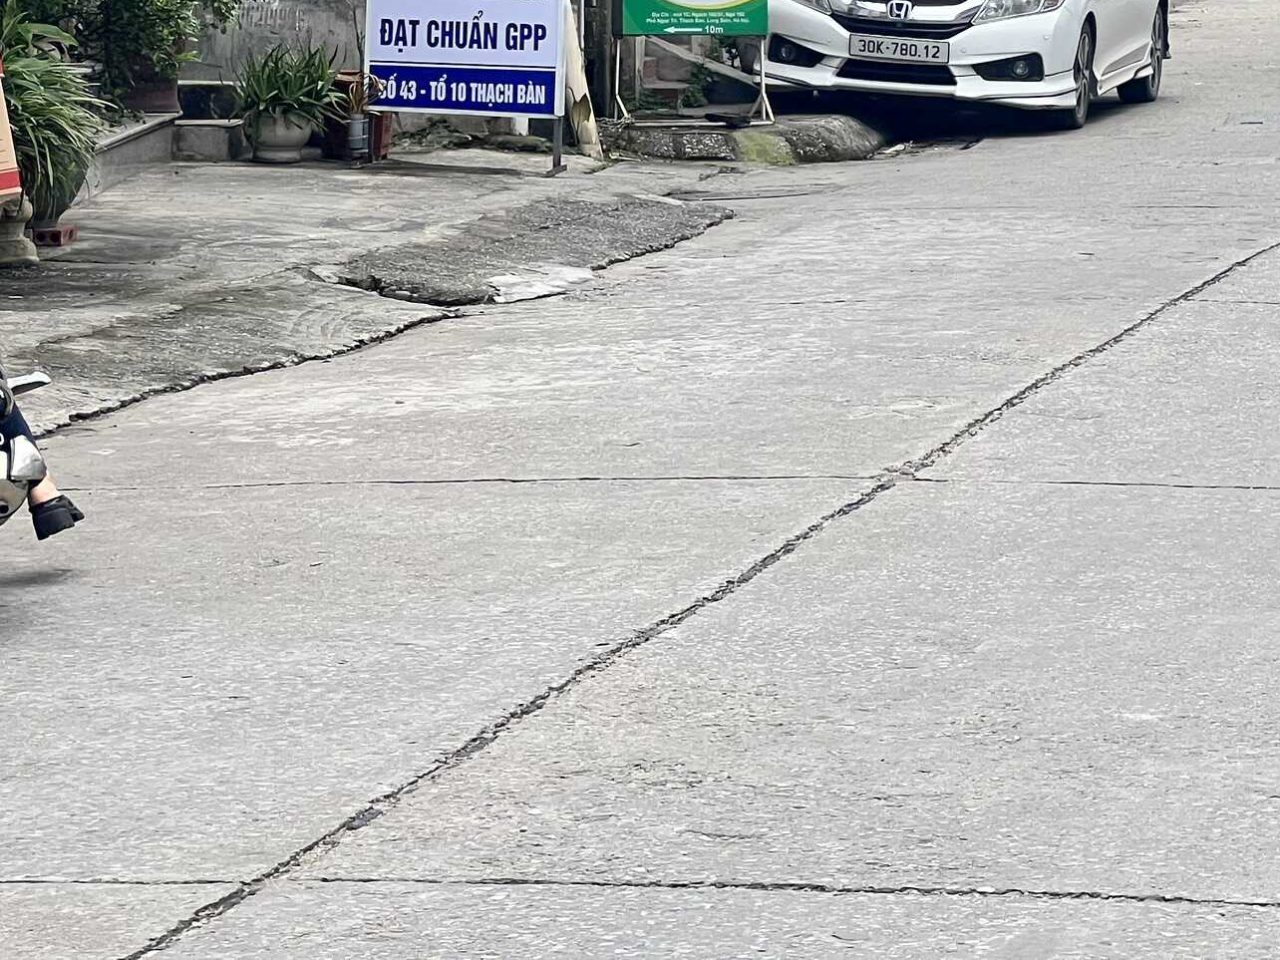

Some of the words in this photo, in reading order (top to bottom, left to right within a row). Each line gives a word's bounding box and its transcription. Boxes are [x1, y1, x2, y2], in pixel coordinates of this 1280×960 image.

[379, 18, 420, 53] ĐẠT
[426, 10, 498, 50] CHUẨN
[505, 22, 547, 51] GPP
[705, 25, 723, 34] 10m
[858, 39, 941, 60] 30K-780.12
[400, 80, 417, 100] 43
[430, 74, 447, 101] TỔ
[450, 82, 467, 102] 10
[470, 82, 513, 107] THẠCH
[516, 80, 546, 105] BÀN
